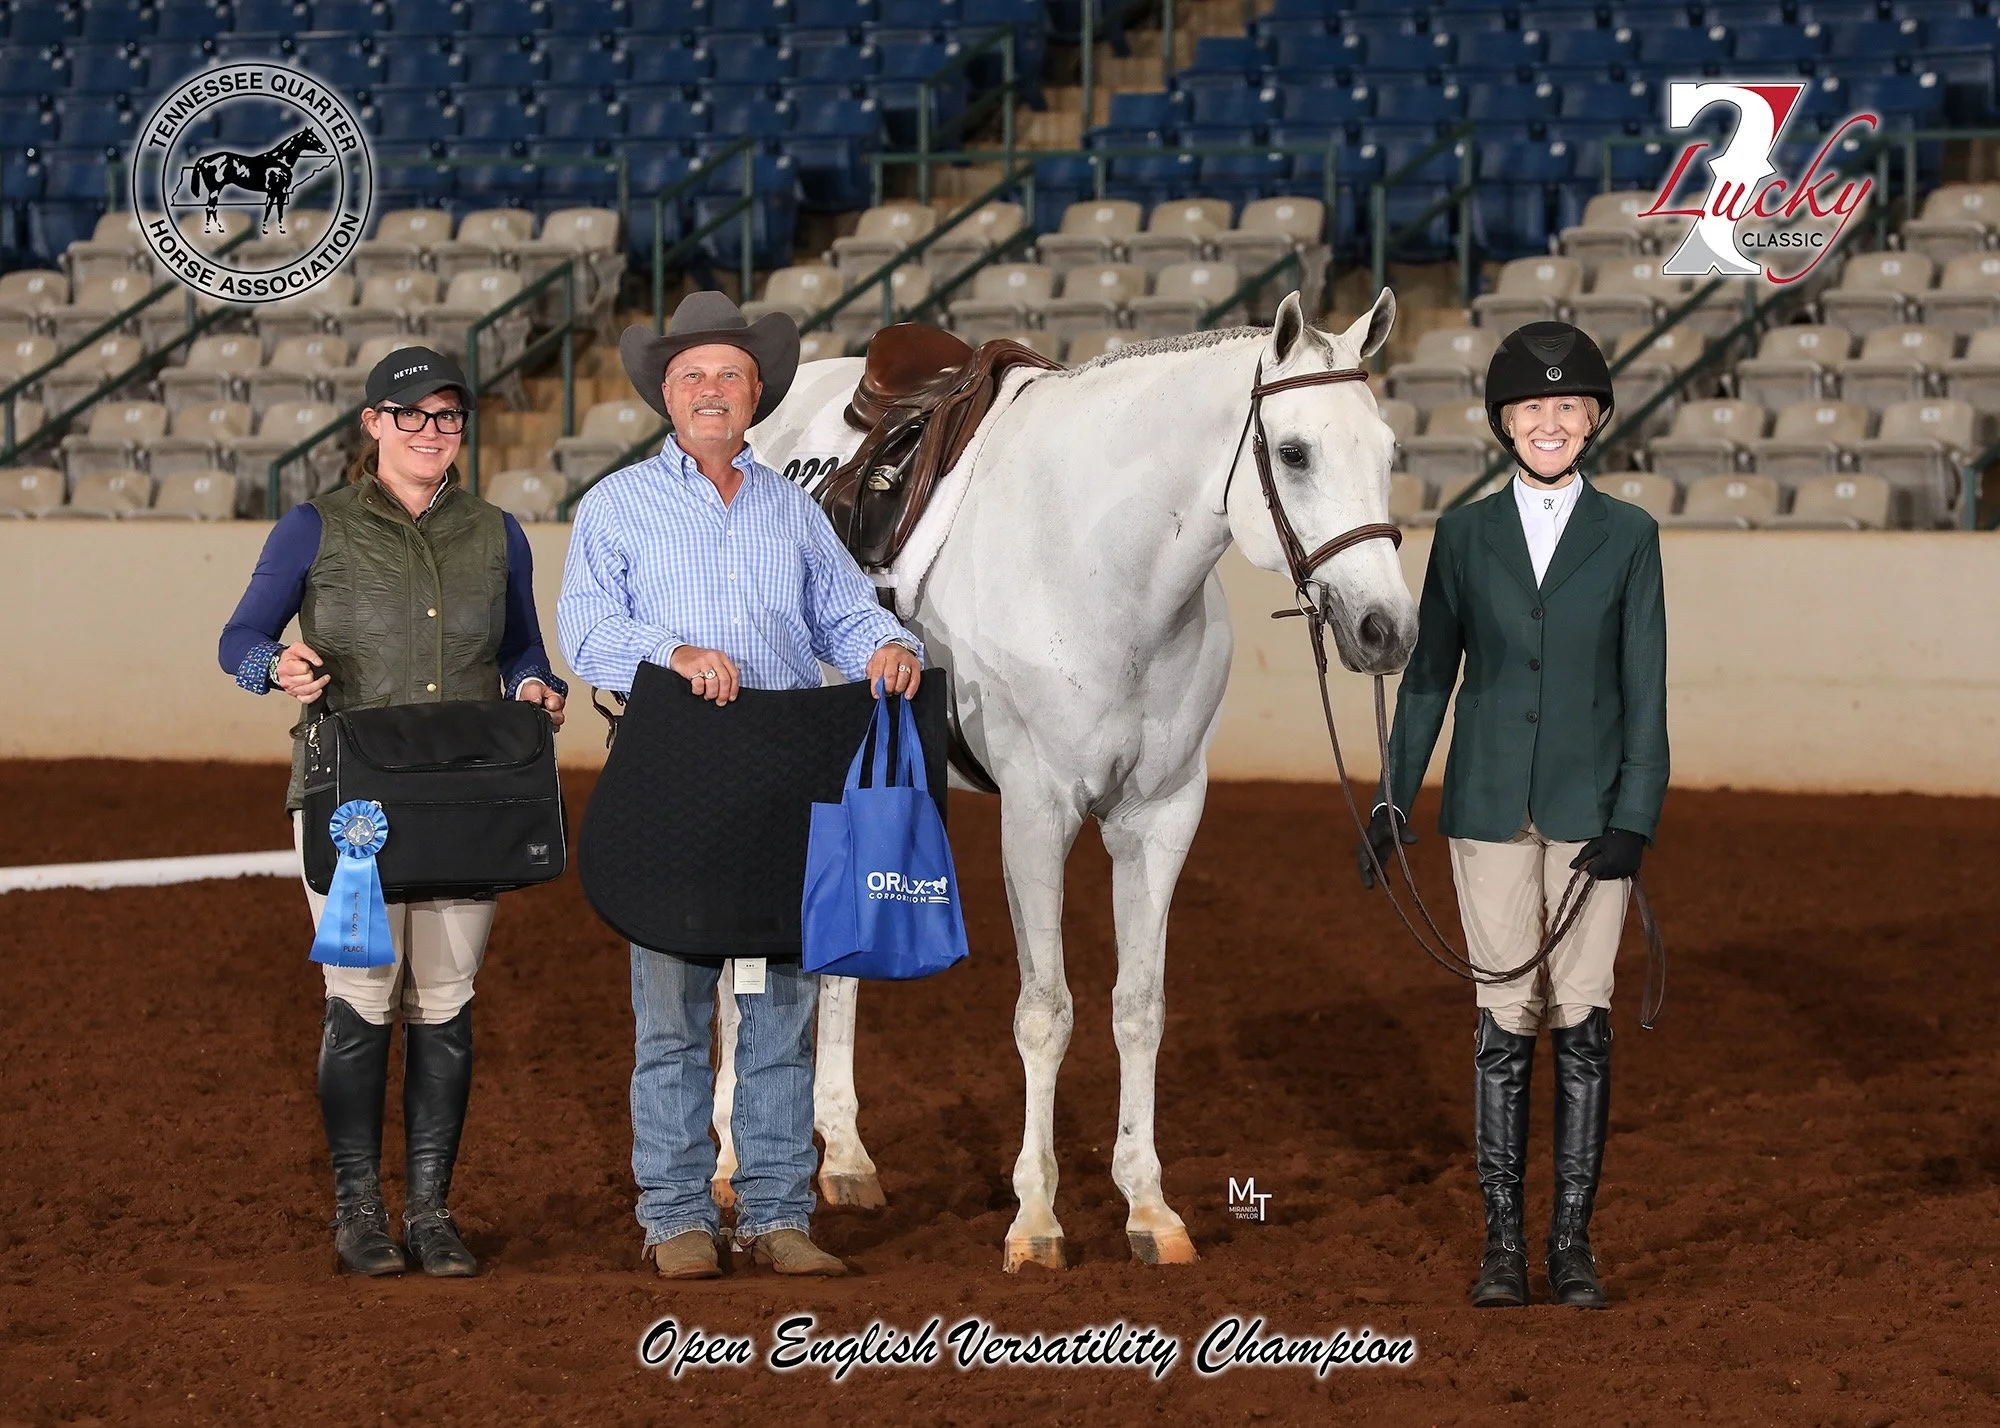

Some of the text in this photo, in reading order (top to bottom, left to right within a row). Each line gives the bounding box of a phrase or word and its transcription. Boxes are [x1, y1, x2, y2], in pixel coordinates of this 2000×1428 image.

[393, 364, 429, 380] NETJETS
[866, 871, 927, 895] ORALX
[343, 944, 366, 953] PLACE
